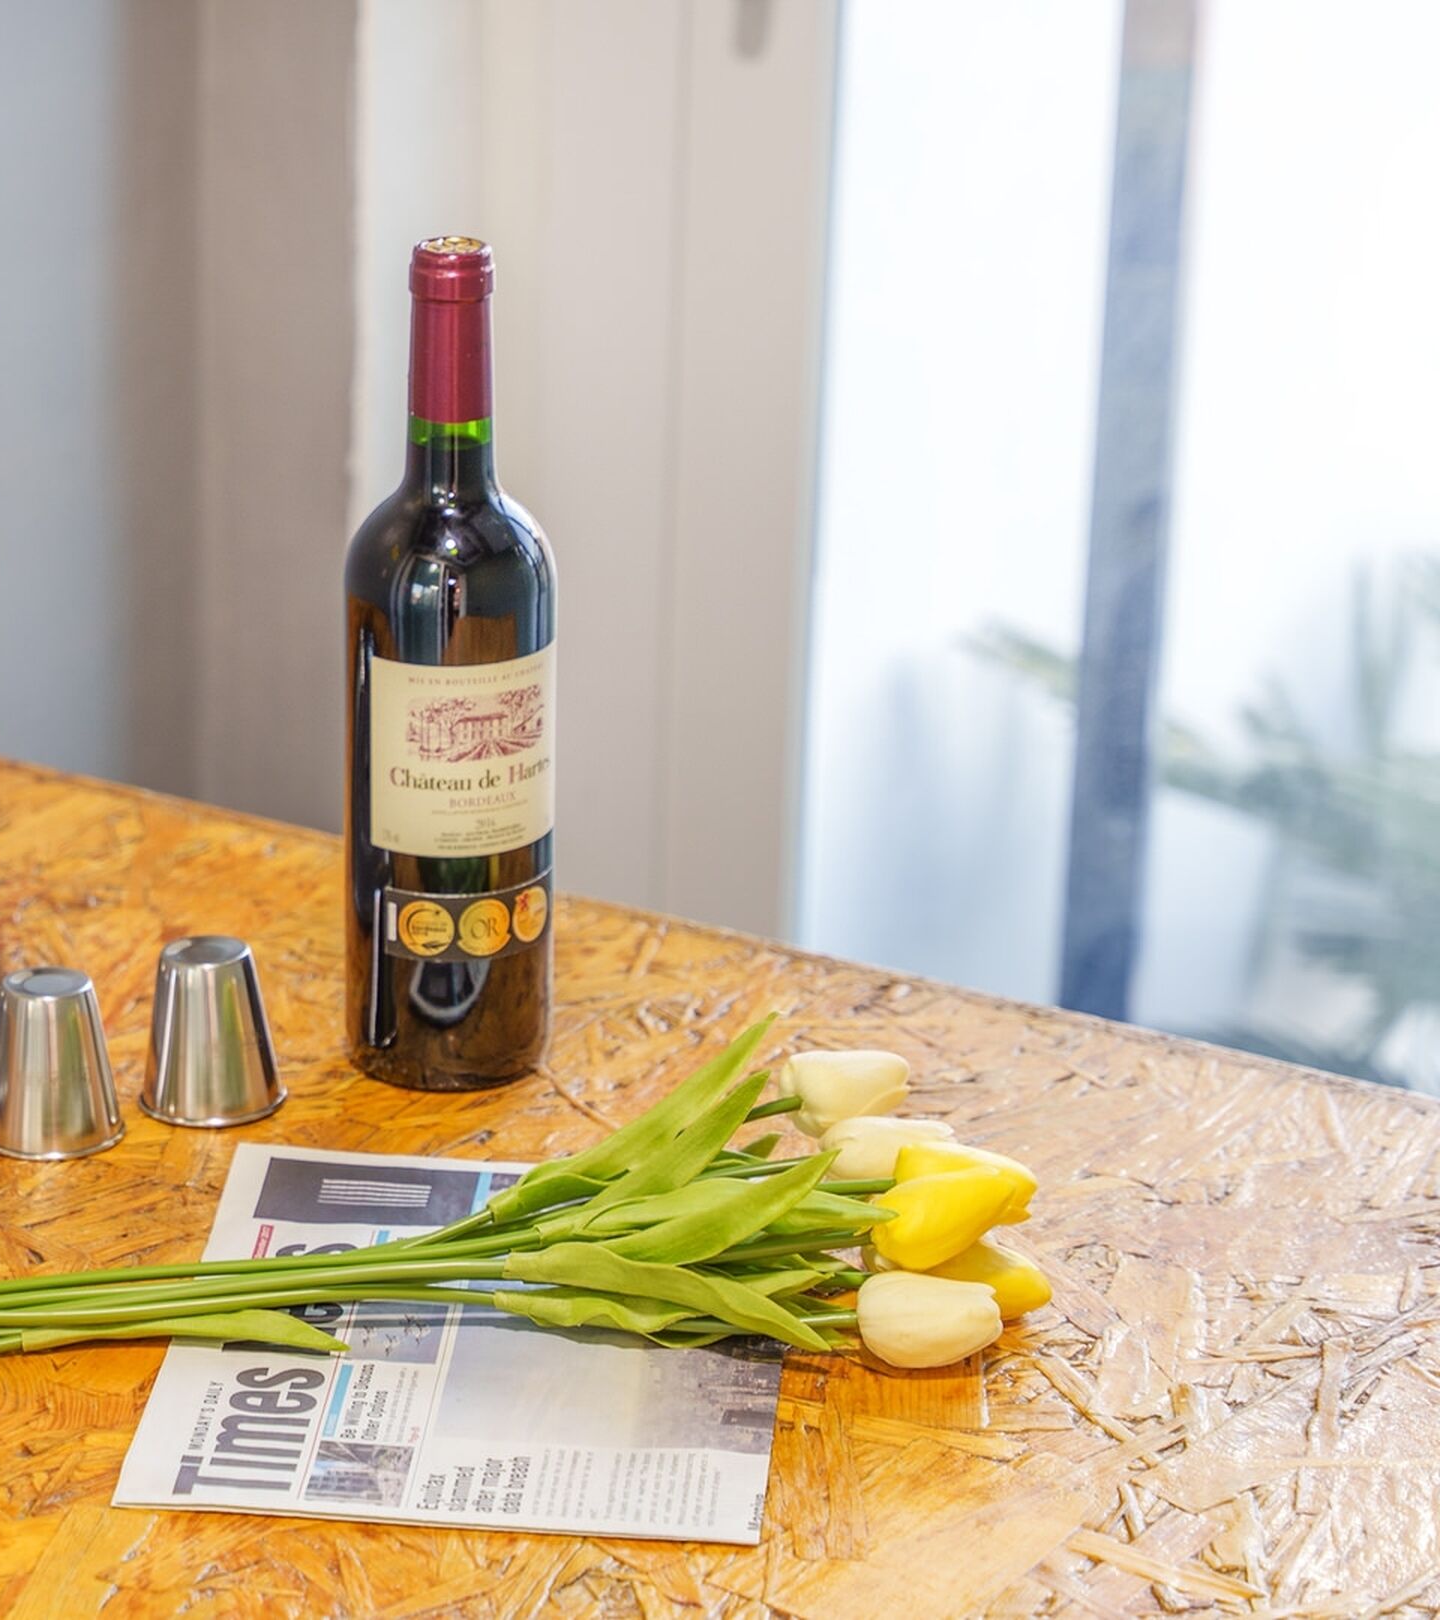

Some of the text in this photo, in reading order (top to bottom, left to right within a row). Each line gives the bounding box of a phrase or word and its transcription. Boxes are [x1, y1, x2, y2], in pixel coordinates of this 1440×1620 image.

[389, 766, 472, 791] Château
[478, 769, 501, 788] de
[449, 791, 517, 809] BORDEAUX
[470, 917, 500, 939] OR
[342, 1401, 368, 1426] Willing
[350, 1391, 368, 1399] to
[172, 1366, 326, 1496] Times
[188, 1380, 225, 1450] MONDAY'S DAILY
[339, 1428, 358, 1440] Be
[360, 1390, 389, 1441] Other Options
[416, 1473, 447, 1511] Equifax
[445, 1465, 476, 1512] slammed
[470, 1458, 506, 1513] after major
[497, 1456, 532, 1514] data breach
